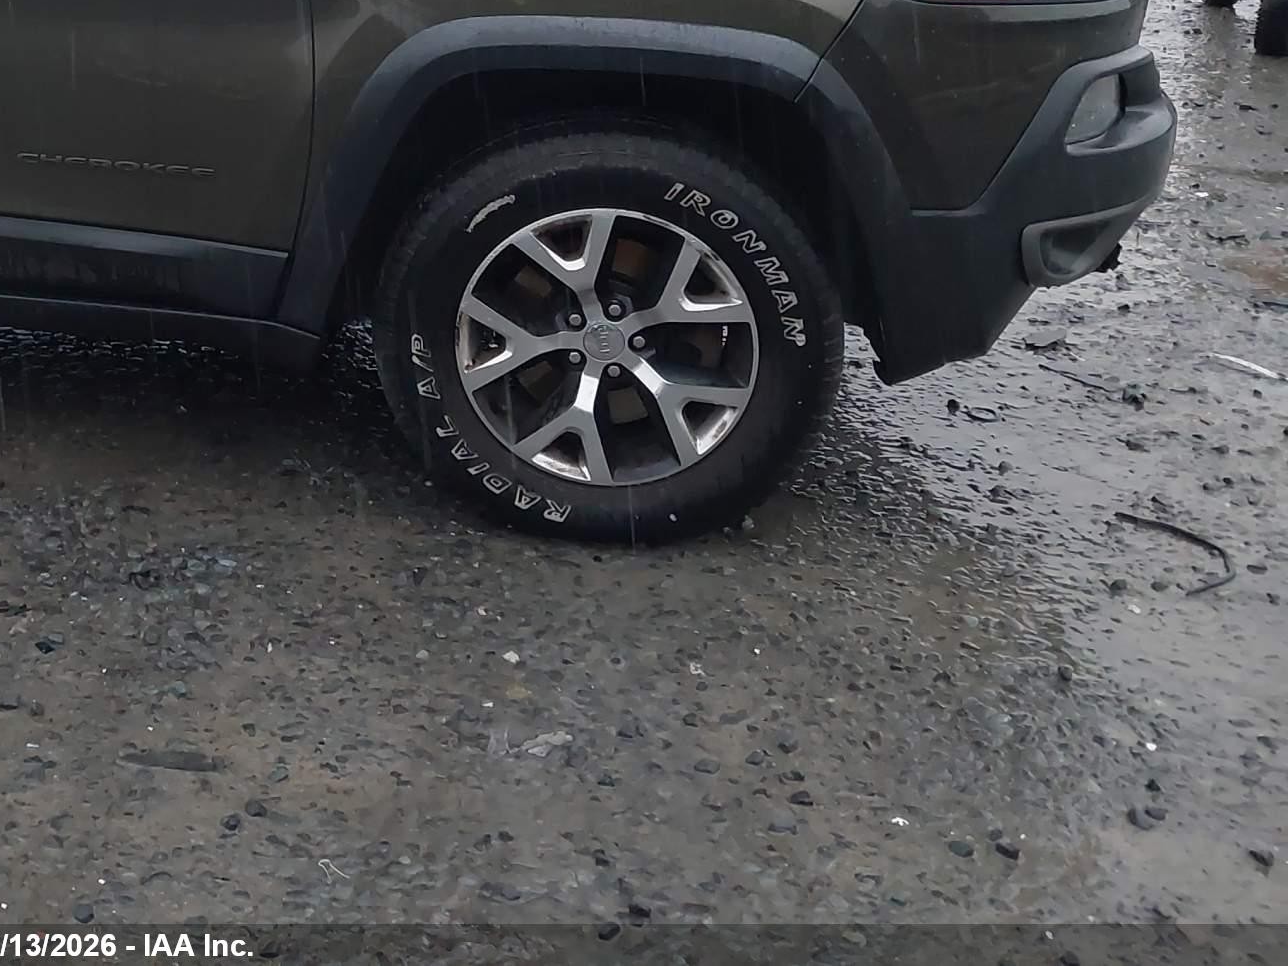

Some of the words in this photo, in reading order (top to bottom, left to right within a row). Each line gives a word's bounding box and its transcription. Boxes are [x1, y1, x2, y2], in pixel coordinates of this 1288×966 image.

[17, 151, 216, 178] CHEROKEE
[663, 182, 808, 348] IRONMAN
[411, 333, 442, 401] A/P
[435, 414, 572, 523] RADIAL
